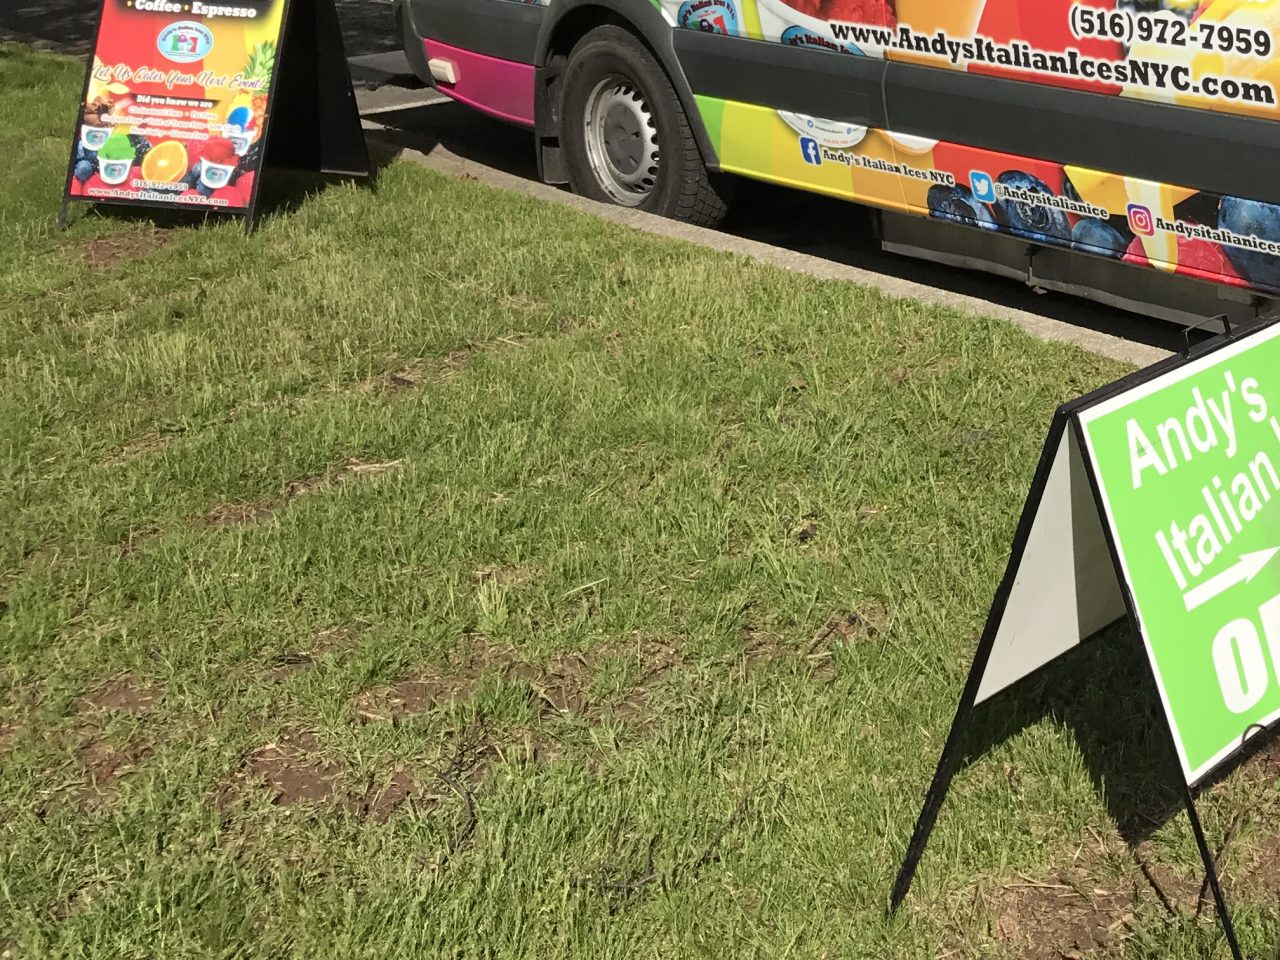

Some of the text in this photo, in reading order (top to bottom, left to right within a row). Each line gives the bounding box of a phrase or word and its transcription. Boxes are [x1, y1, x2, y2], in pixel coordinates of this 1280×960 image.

[191, 2, 257, 18] Espresso
[1071, 6, 1271, 57] (516)972-7959
[92, 65, 265, 89] Let Us Cater Your Next Event!
[829, 23, 1275, 105] www.AndysItalianIcesNYC.com
[136, 94, 151, 103] Did
[151, 97, 165, 106] you
[166, 96, 188, 106] know
[823, 148, 955, 186] Andy's Italian Ices NYC
[1125, 370, 1270, 490] Andy's
